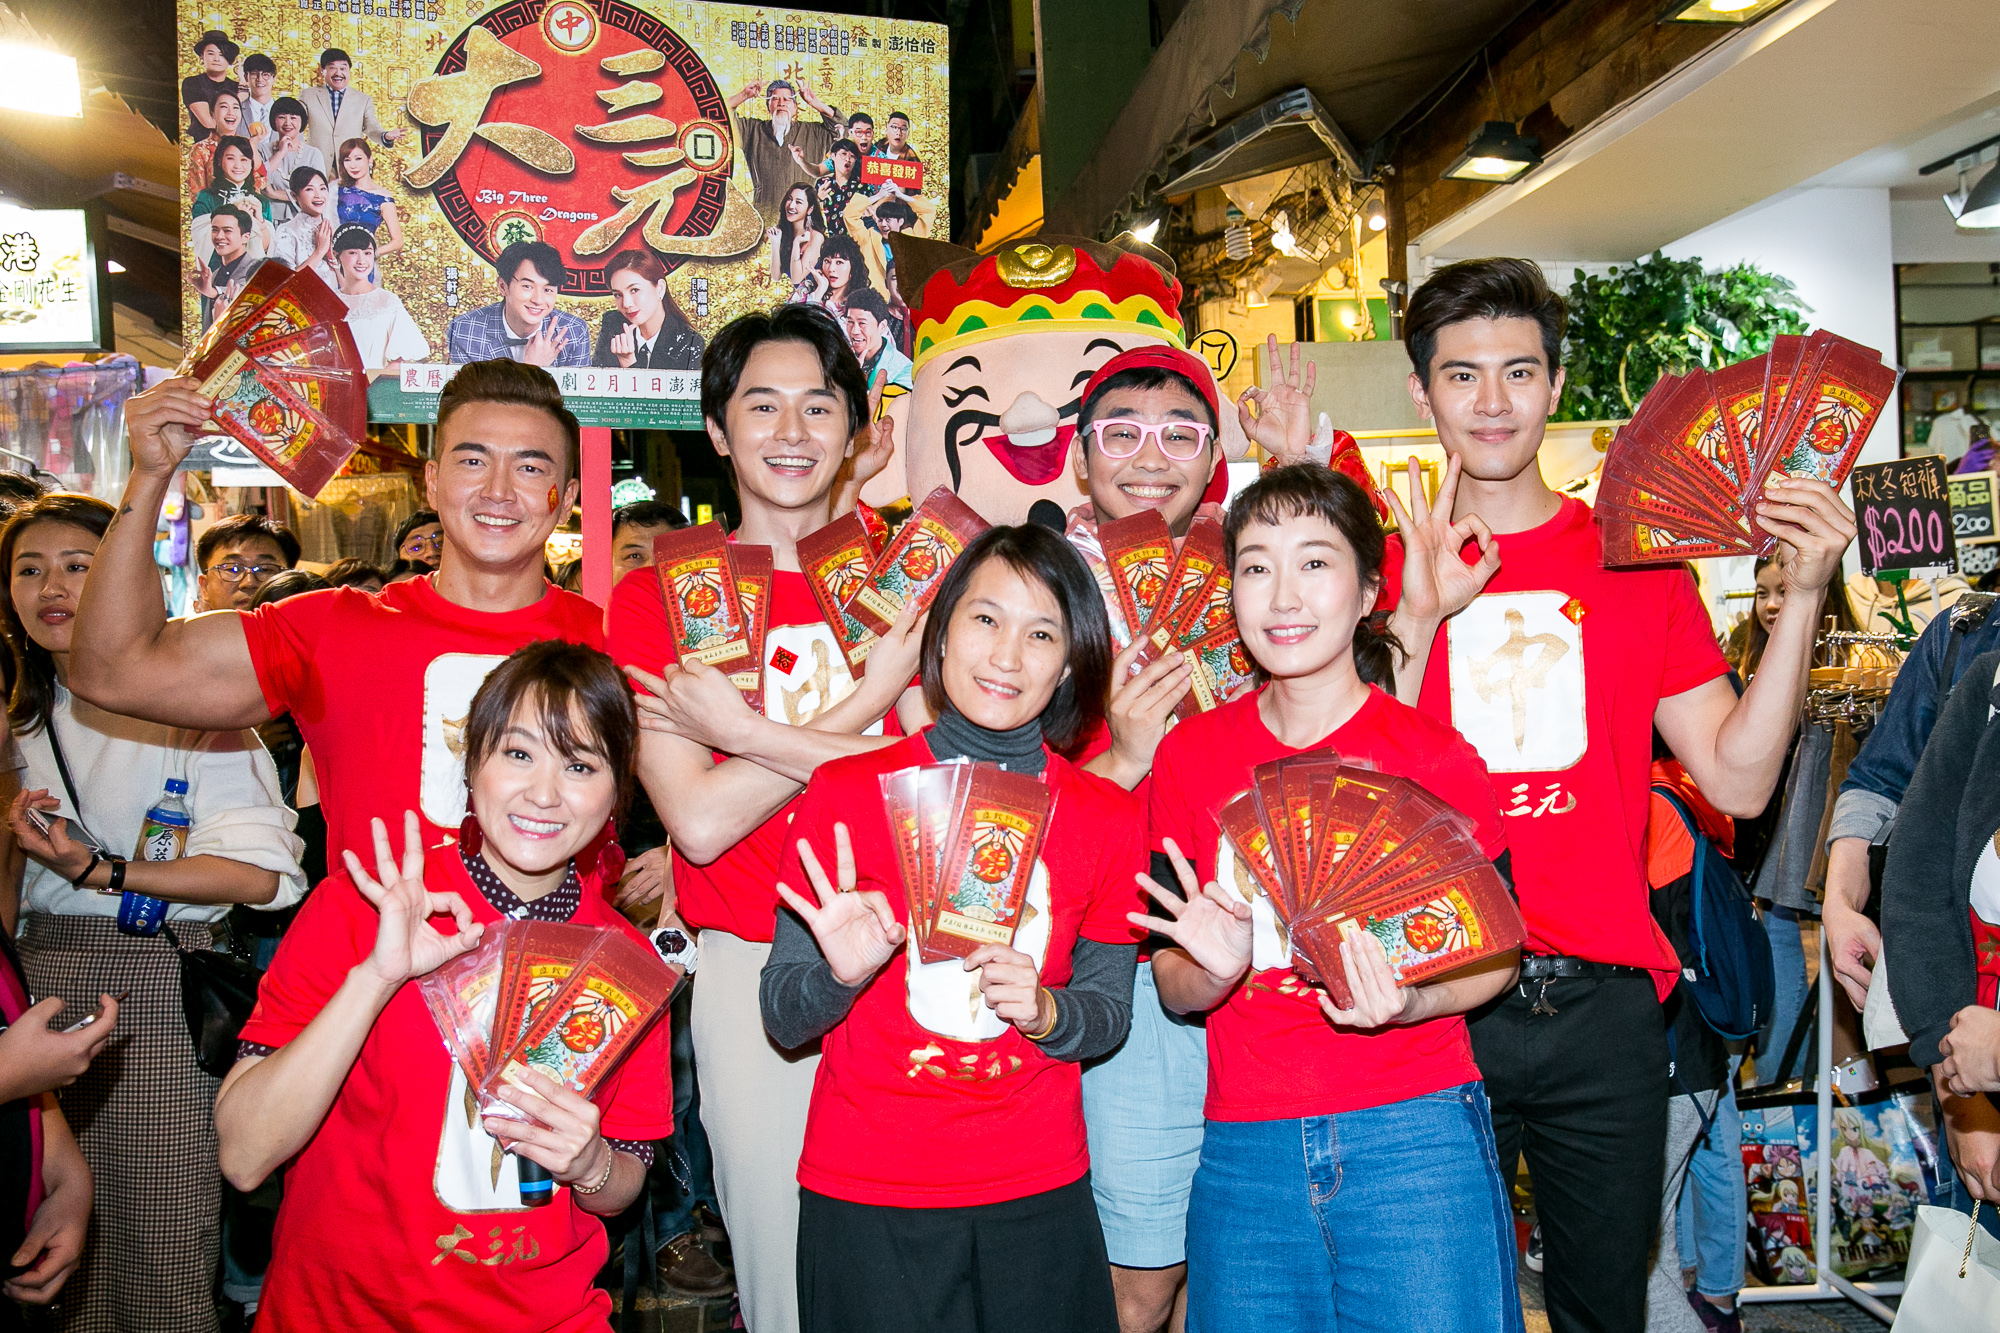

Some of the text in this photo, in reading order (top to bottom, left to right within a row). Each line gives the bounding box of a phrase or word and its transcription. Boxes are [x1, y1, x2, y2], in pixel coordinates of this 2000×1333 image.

[556, 11, 586, 40] 中
[888, 36, 936, 54] 澎恰恰
[401, 25, 764, 257] 大三元
[867, 160, 918, 180] 恭喜發財
[475, 190, 548, 205] Big Three
[539, 207, 599, 222] Dragons
[1815, 420, 1843, 448] 大三元
[1855, 460, 1941, 502] 秋冬短褲
[1864, 504, 1944, 568] $200
[1952, 513, 1991, 535] 200
[910, 551, 935, 577] 大三元
[690, 589, 715, 616] 大三元
[776, 650, 794, 669] 春
[1467, 608, 1570, 755] 中
[1498, 783, 1577, 818] 三元
[979, 845, 1007, 878] 大三元
[567, 1015, 602, 1047] 大三元
[906, 1041, 1022, 1084] 大三元
[431, 1223, 540, 1266] 大三元
